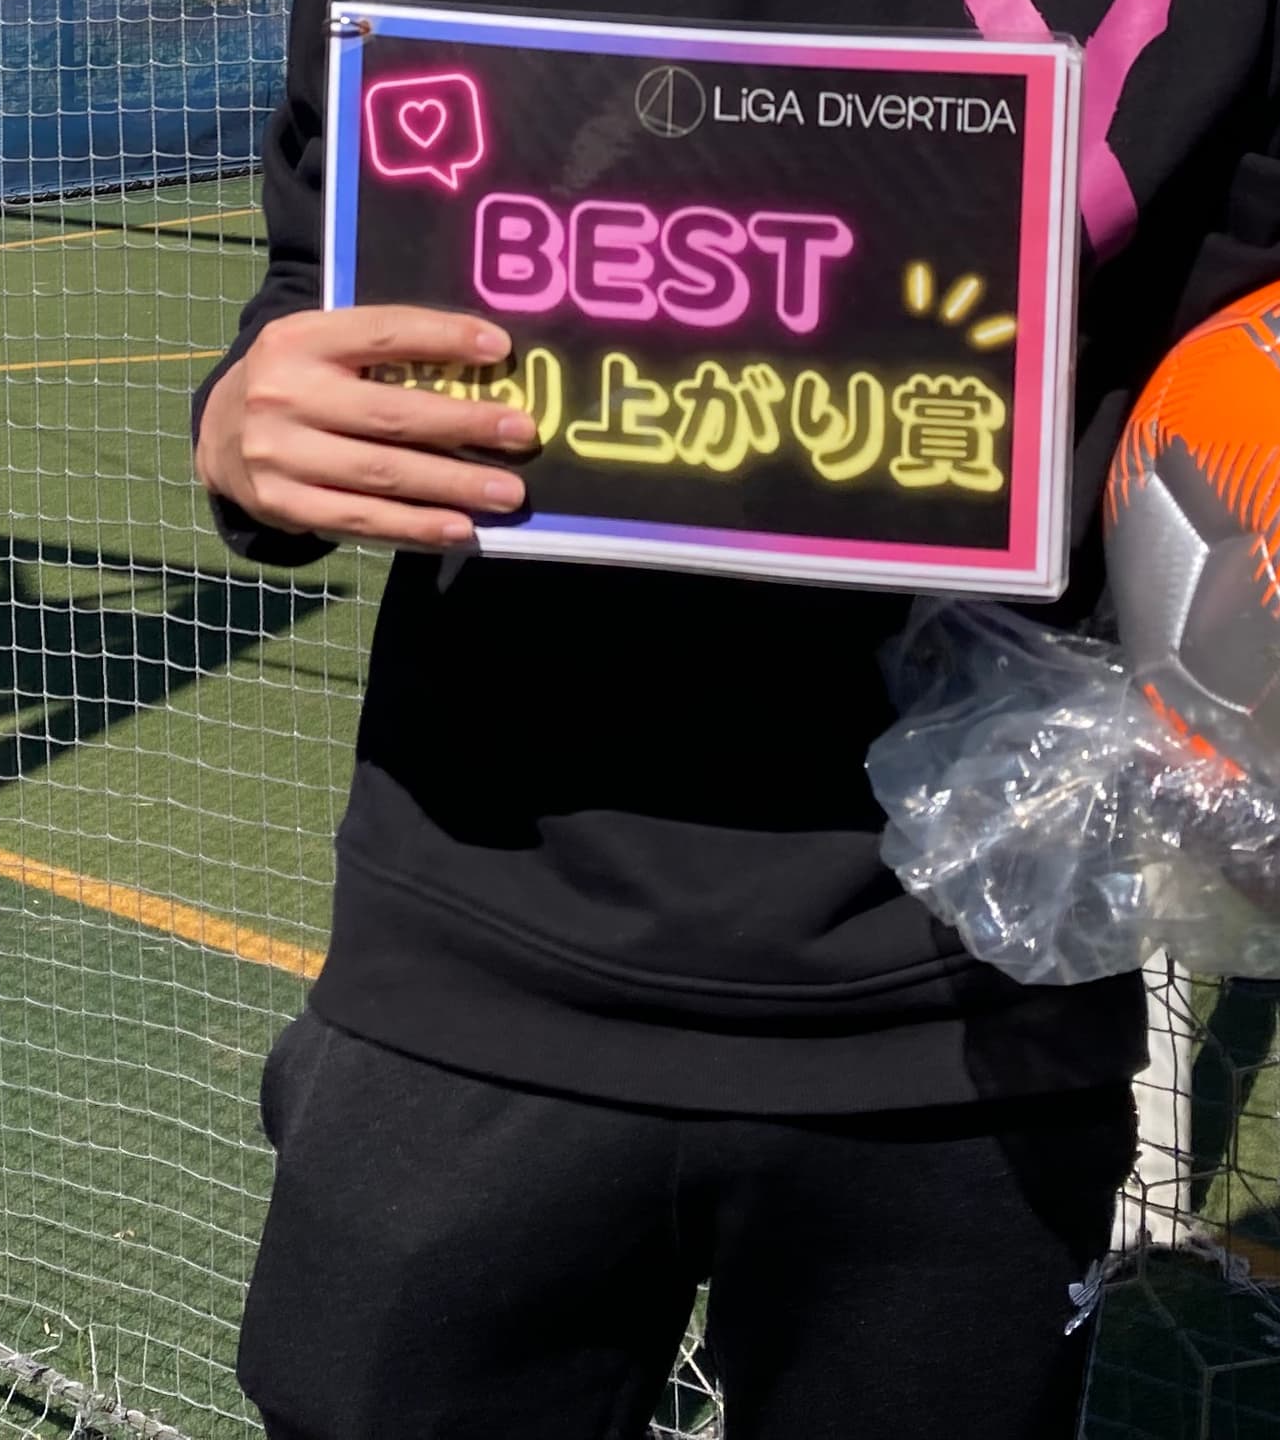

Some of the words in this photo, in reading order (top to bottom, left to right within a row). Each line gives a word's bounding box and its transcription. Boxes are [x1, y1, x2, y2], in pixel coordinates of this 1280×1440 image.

[473, 192, 854, 334] BEST
[368, 347, 1007, 492] り上がり賞
